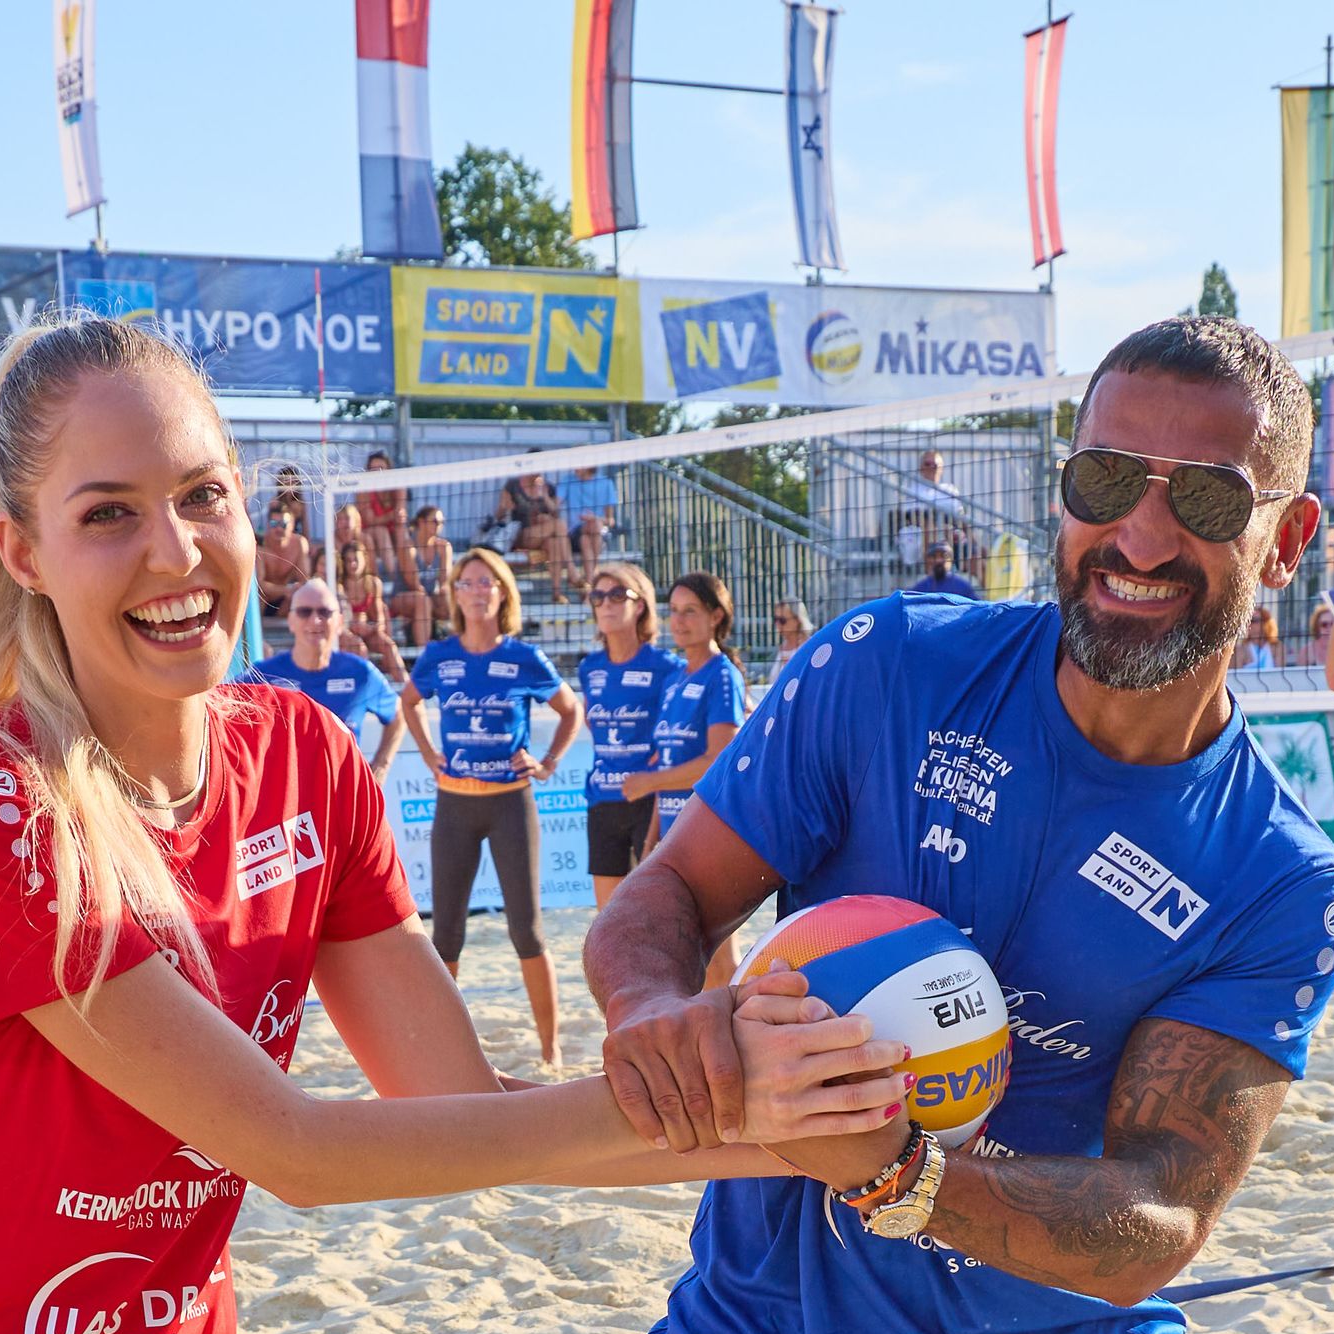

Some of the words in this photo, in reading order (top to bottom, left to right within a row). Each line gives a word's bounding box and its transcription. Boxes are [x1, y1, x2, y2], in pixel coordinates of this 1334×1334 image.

[437, 298, 522, 324] SPORT
[163, 308, 282, 350] HYPO
[295, 312, 382, 351] NOE
[684, 319, 757, 370] NV
[439, 351, 510, 376] LAND
[235, 834, 276, 862] SPORT
[1110, 842, 1161, 880] SPORT
[551, 851, 577, 872] 38
[245, 865, 282, 890] LAND
[1093, 865, 1135, 898] LAND
[923, 981, 939, 992] BALL
[128, 1211, 154, 1231] GAS
